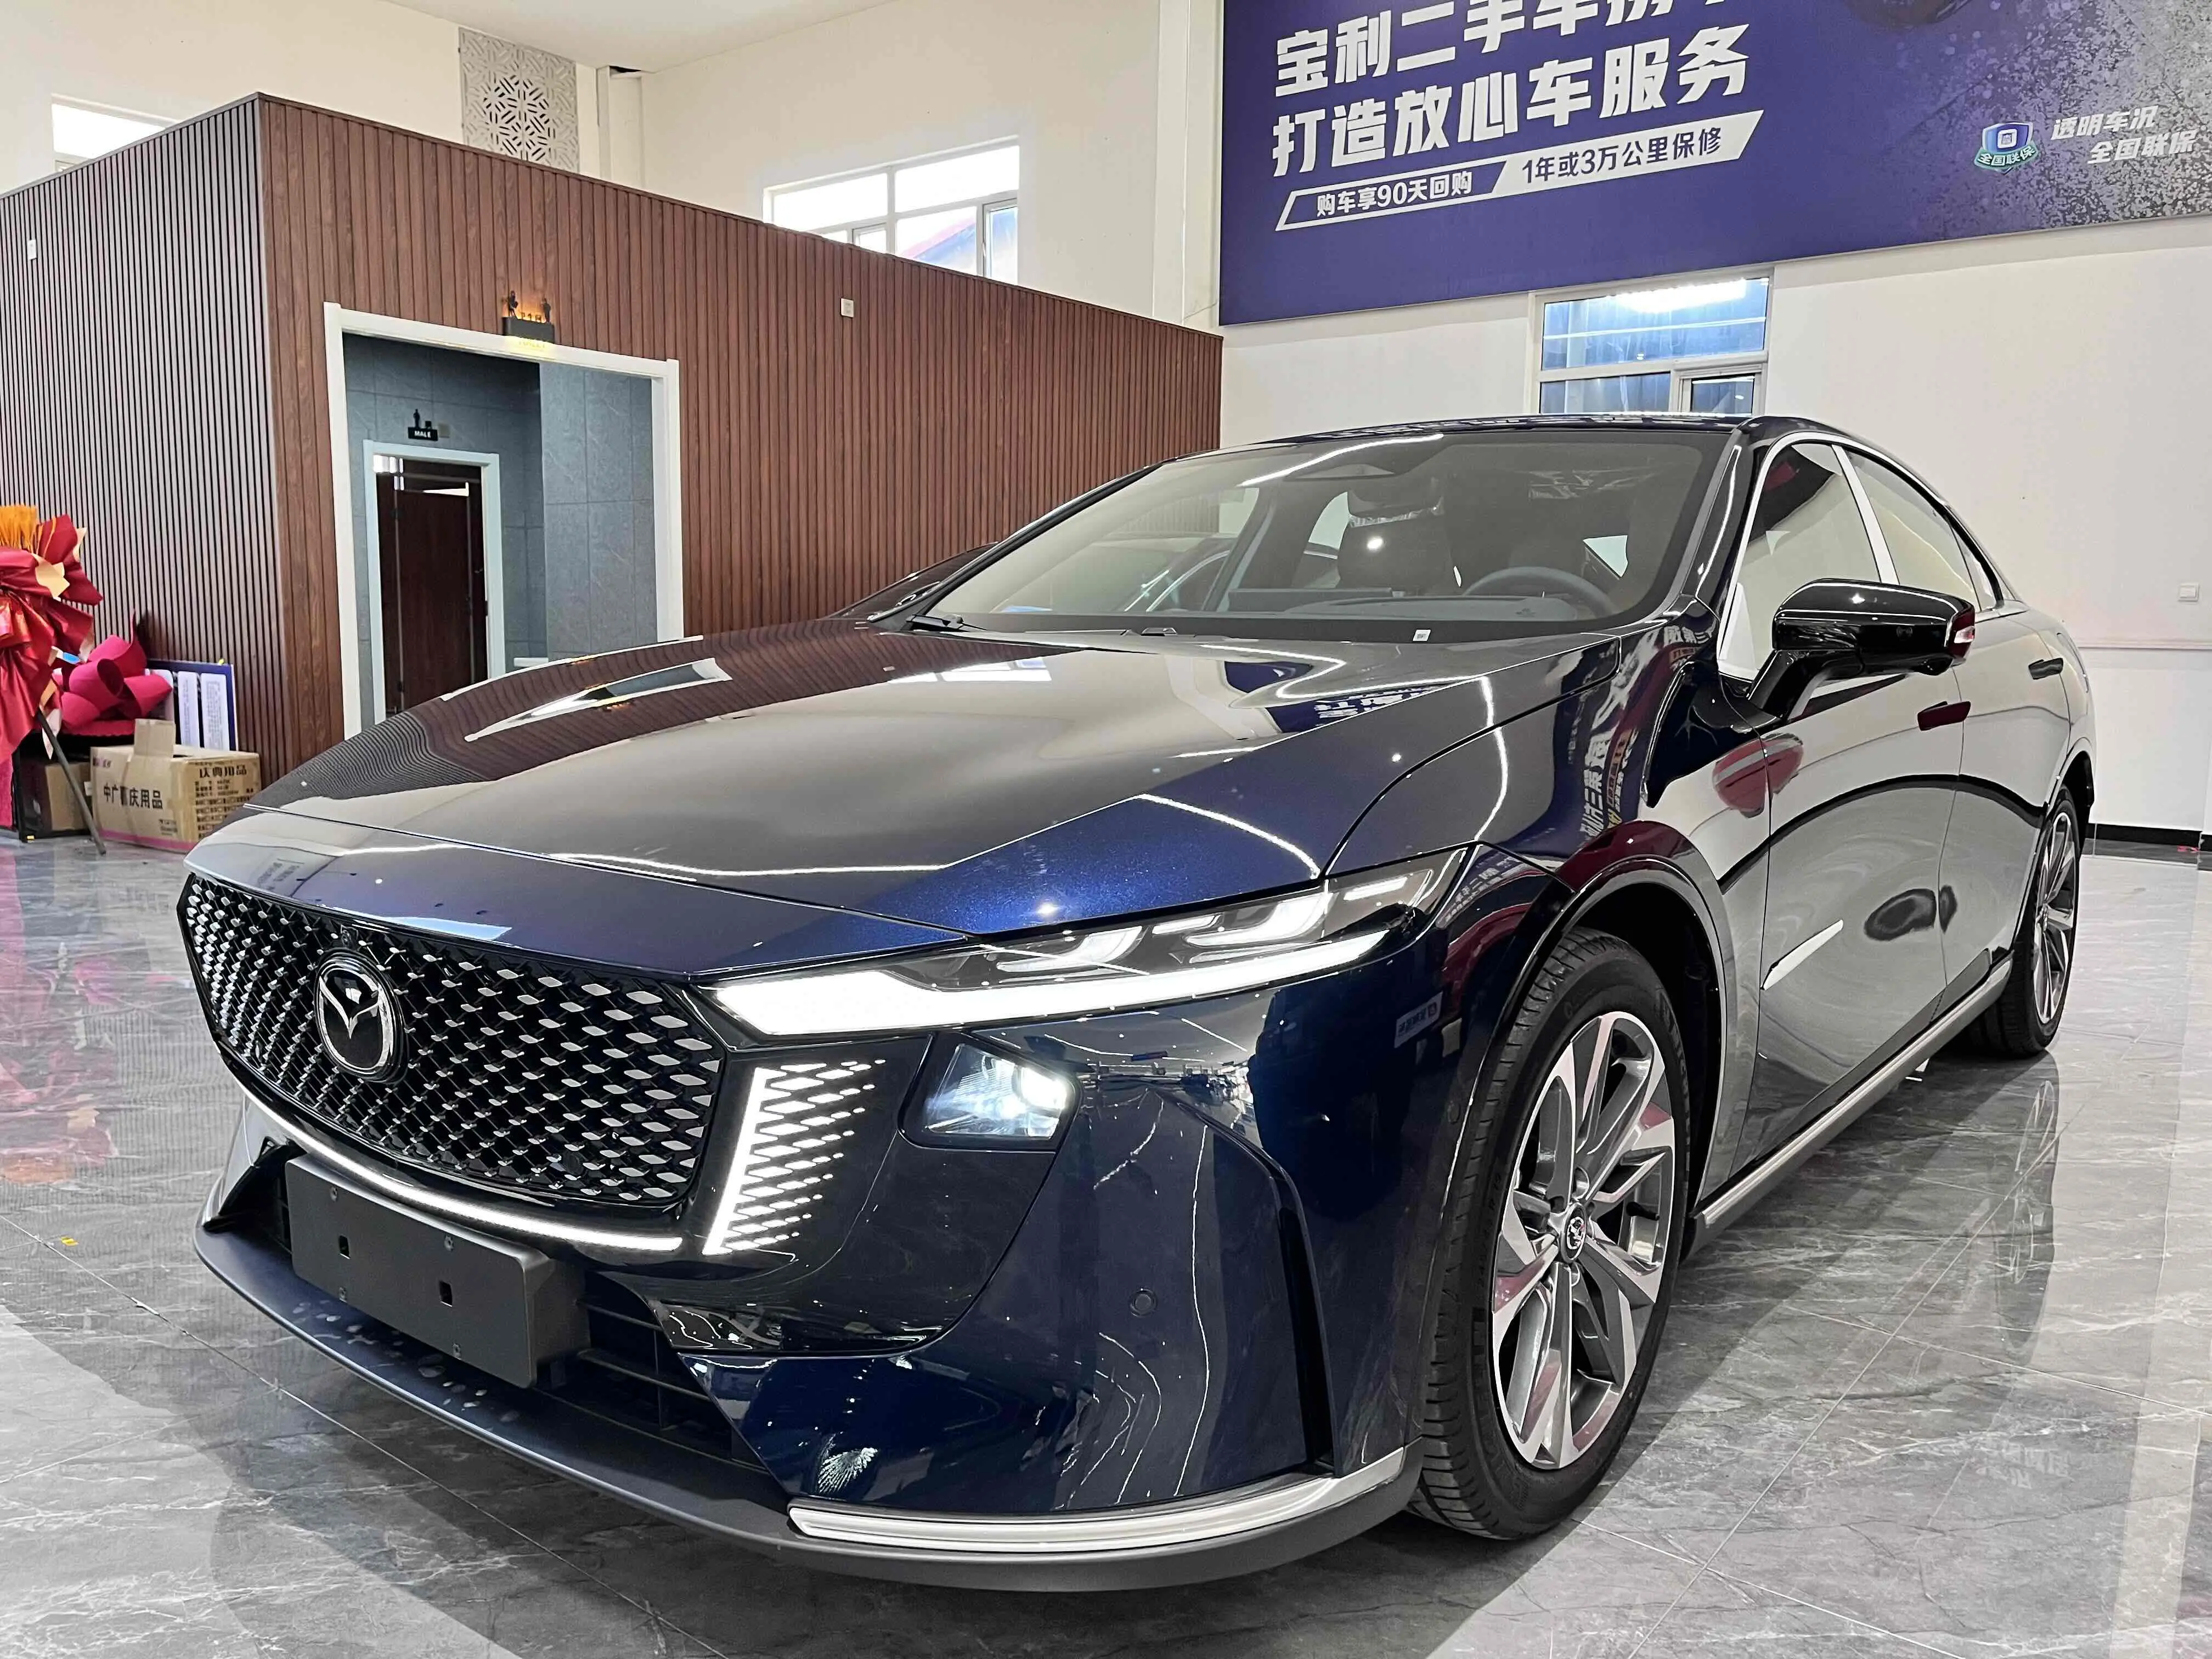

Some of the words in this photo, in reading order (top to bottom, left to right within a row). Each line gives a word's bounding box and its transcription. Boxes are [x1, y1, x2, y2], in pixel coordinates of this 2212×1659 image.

[1272, 23, 1750, 177] 打造放心车服务
[2051, 105, 2159, 140] 透明车况
[1521, 127, 1722, 184] 1年或3万公里保修
[1979, 145, 2036, 167] 全国联保
[2087, 131, 2197, 165] 全国联保
[1316, 171, 1473, 217] 购车享90天回购
